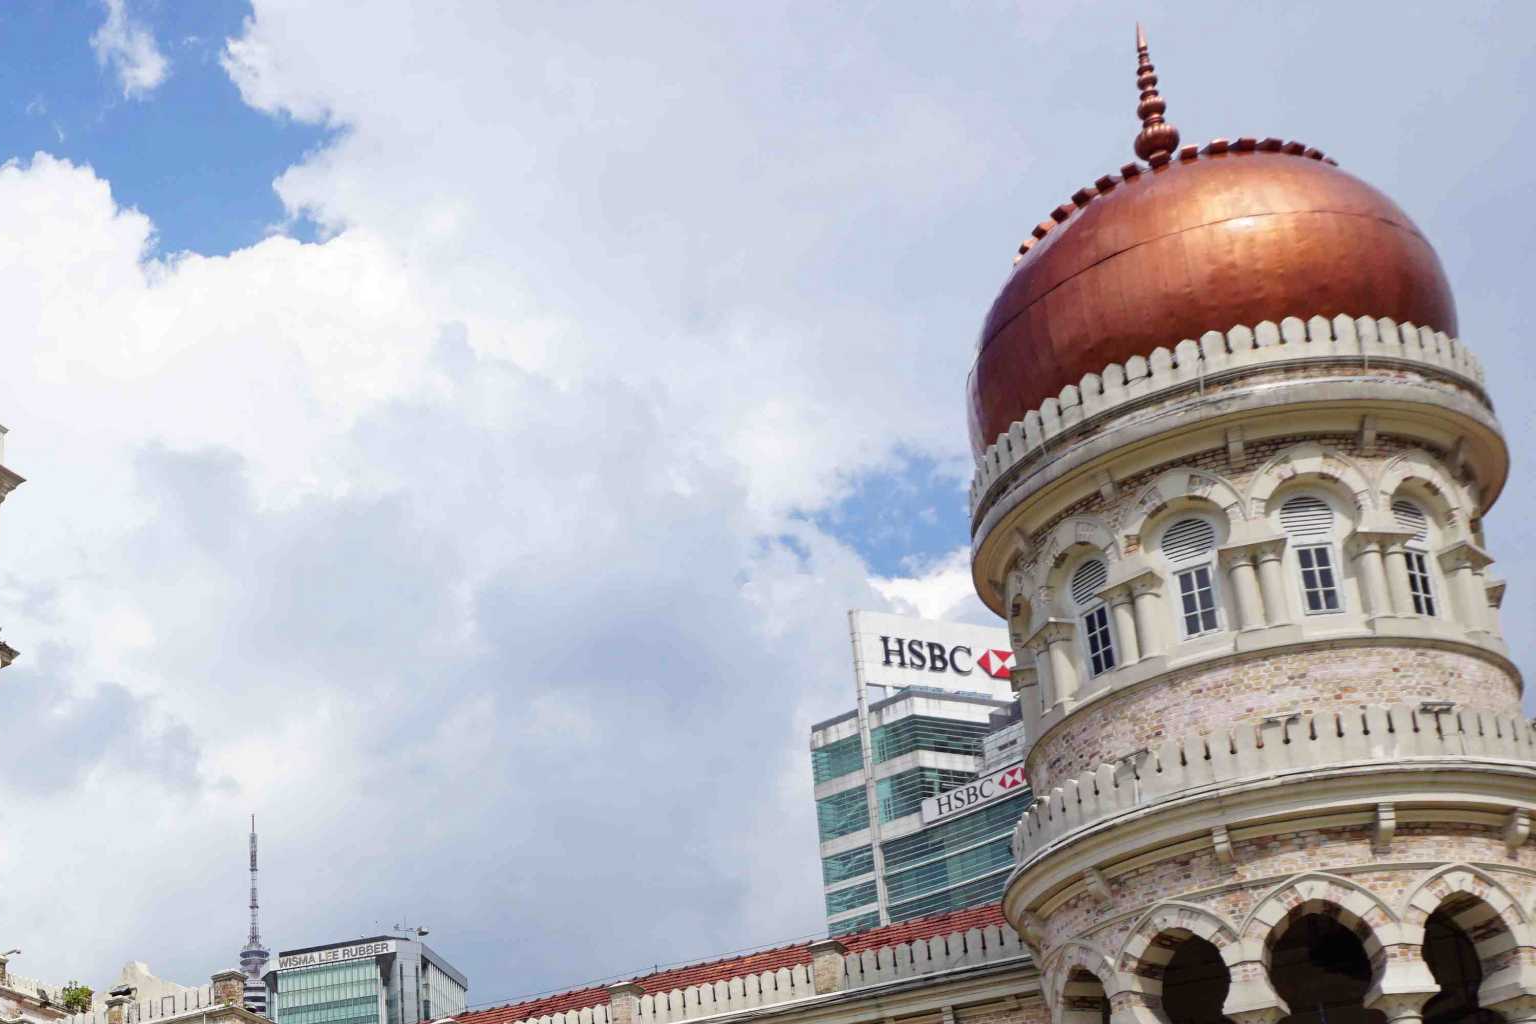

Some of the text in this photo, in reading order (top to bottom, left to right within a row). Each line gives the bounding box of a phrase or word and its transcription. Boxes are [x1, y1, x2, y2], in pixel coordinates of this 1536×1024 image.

[880, 636, 973, 676] HSBC
[936, 778, 995, 816] HSBC
[279, 942, 389, 968] WISMA LEE RUBBER
